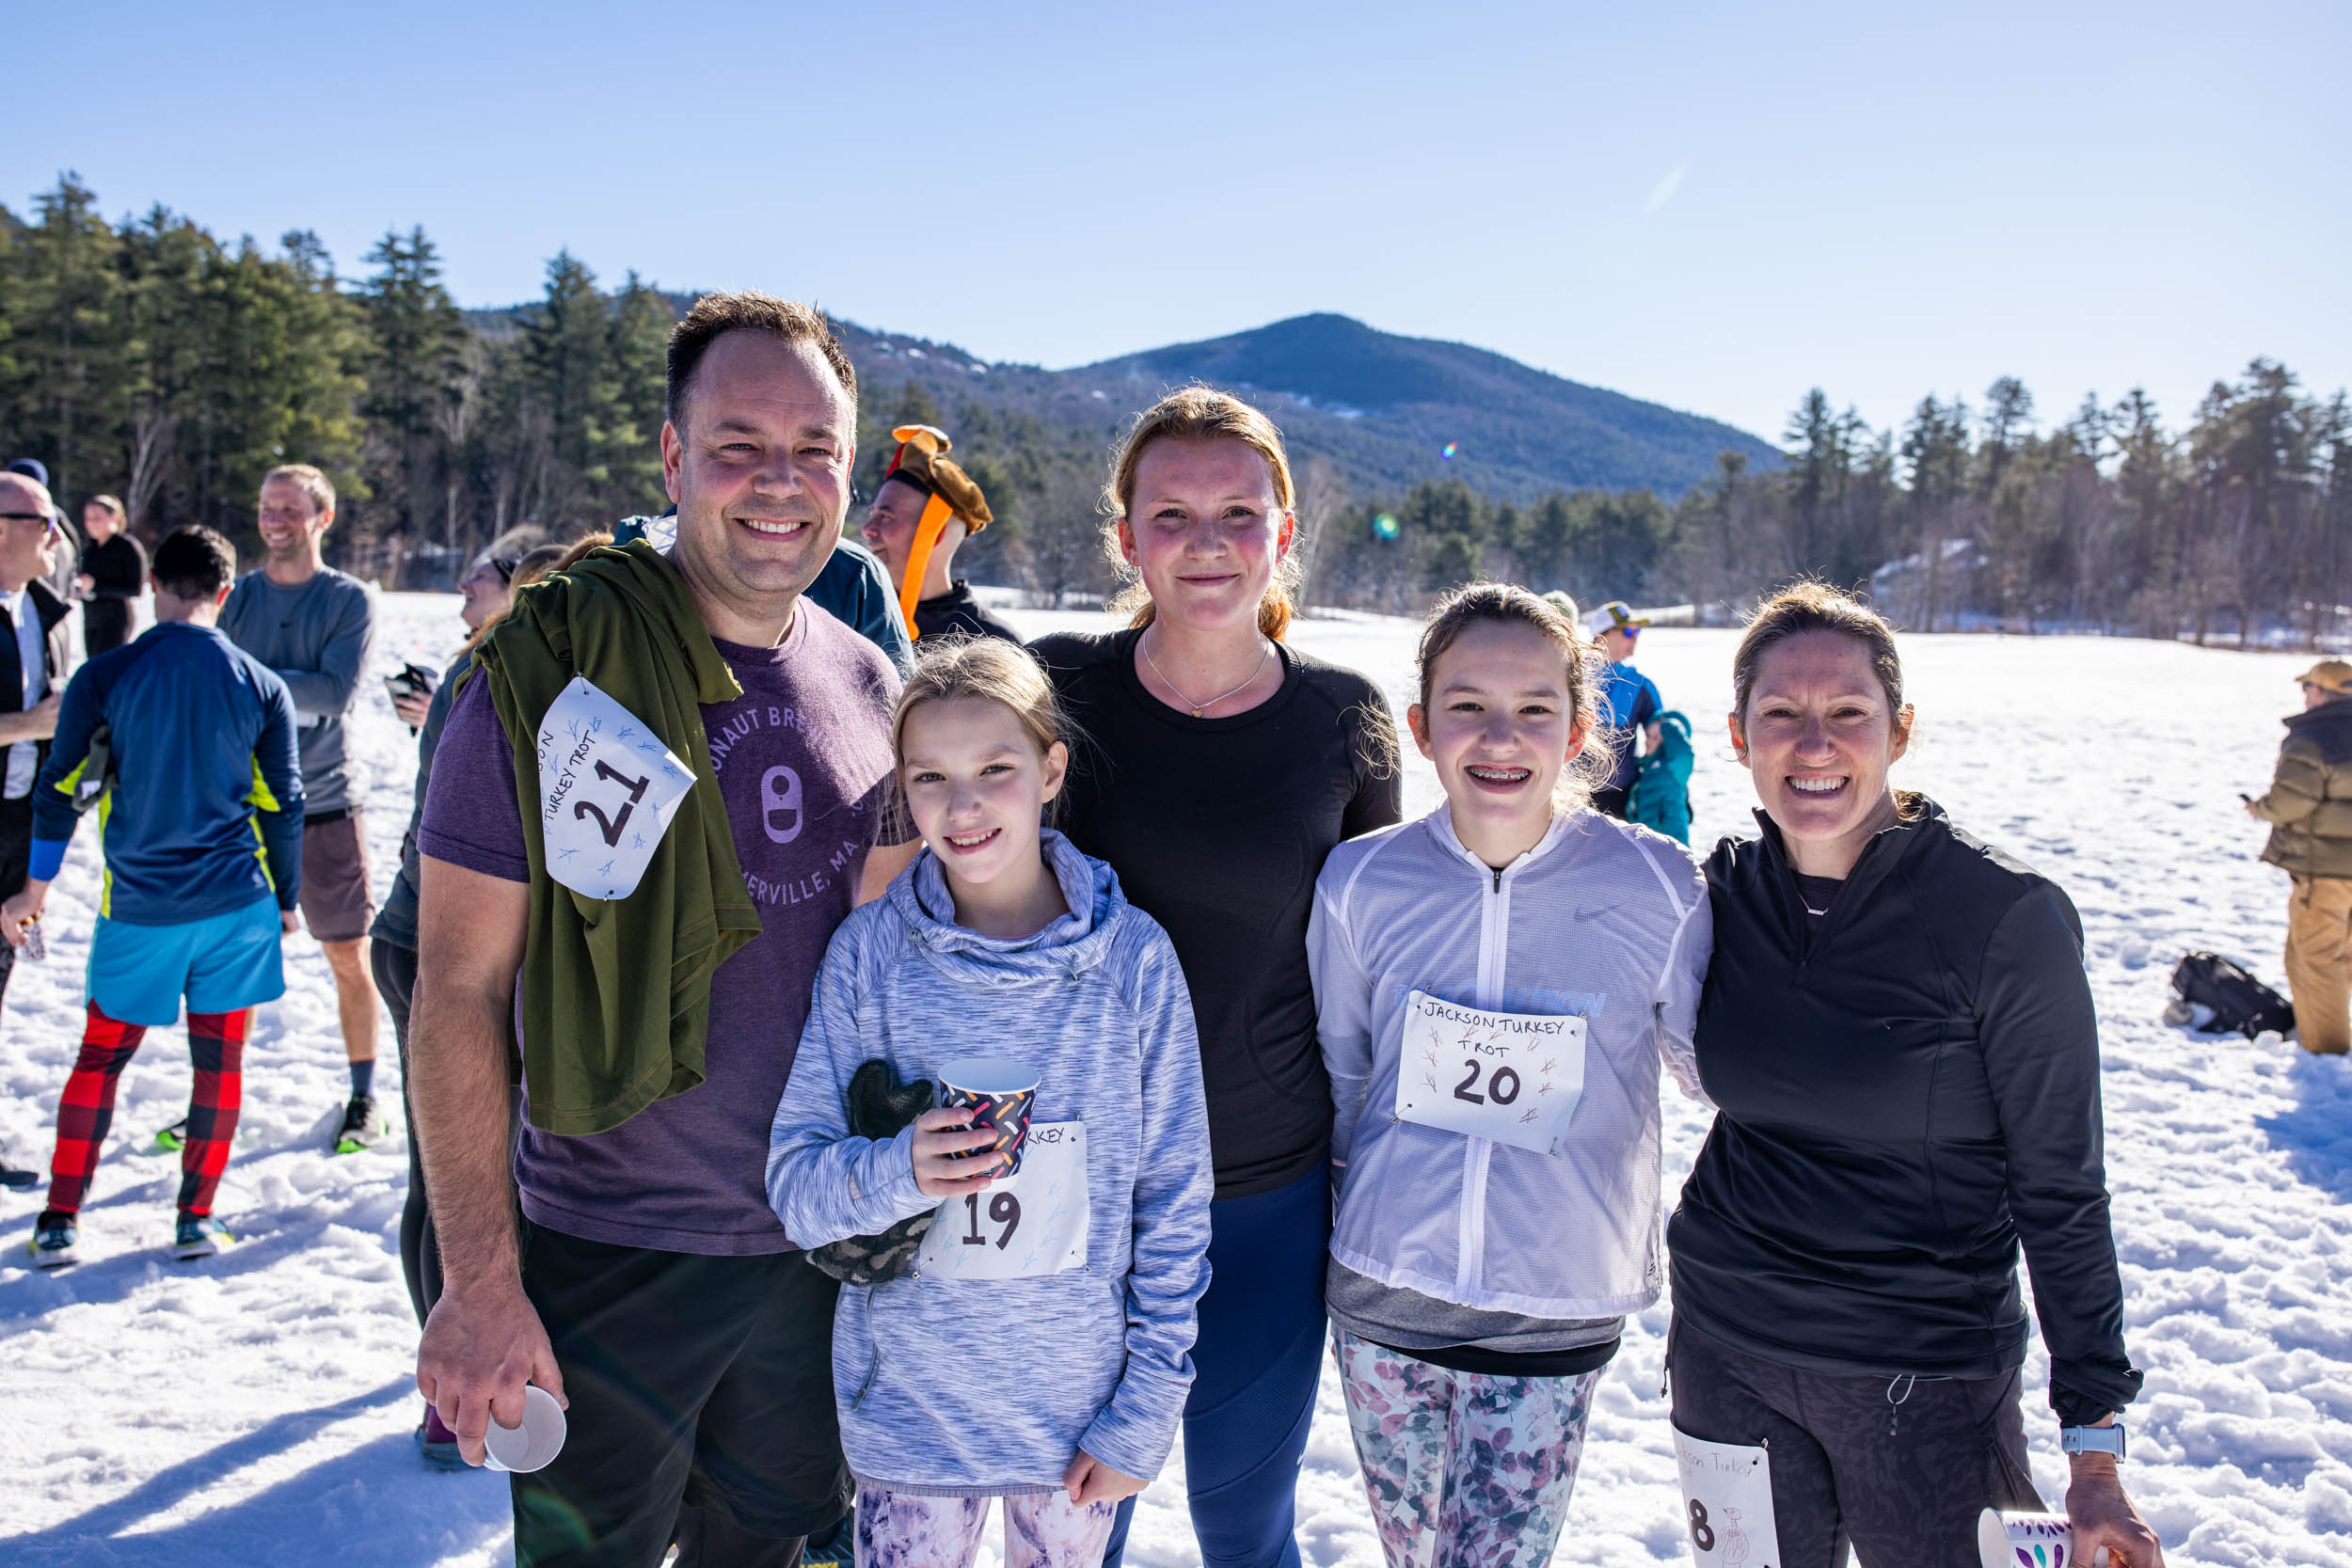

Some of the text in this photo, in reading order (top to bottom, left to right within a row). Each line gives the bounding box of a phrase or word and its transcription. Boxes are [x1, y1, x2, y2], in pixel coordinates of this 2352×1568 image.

[710, 709, 759, 779] ONAUT
[544, 729, 597, 822] TURKEY TROT
[574, 759, 651, 847] 21
[741, 840, 860, 905] ERVILLE, MA
[1424, 1002, 1496, 1029] JACKSON
[1499, 1019, 1565, 1036] TURKEY
[1457, 1039, 1511, 1058] TROT
[1454, 1058, 1521, 1106] 20
[961, 1191, 1022, 1251] 19
